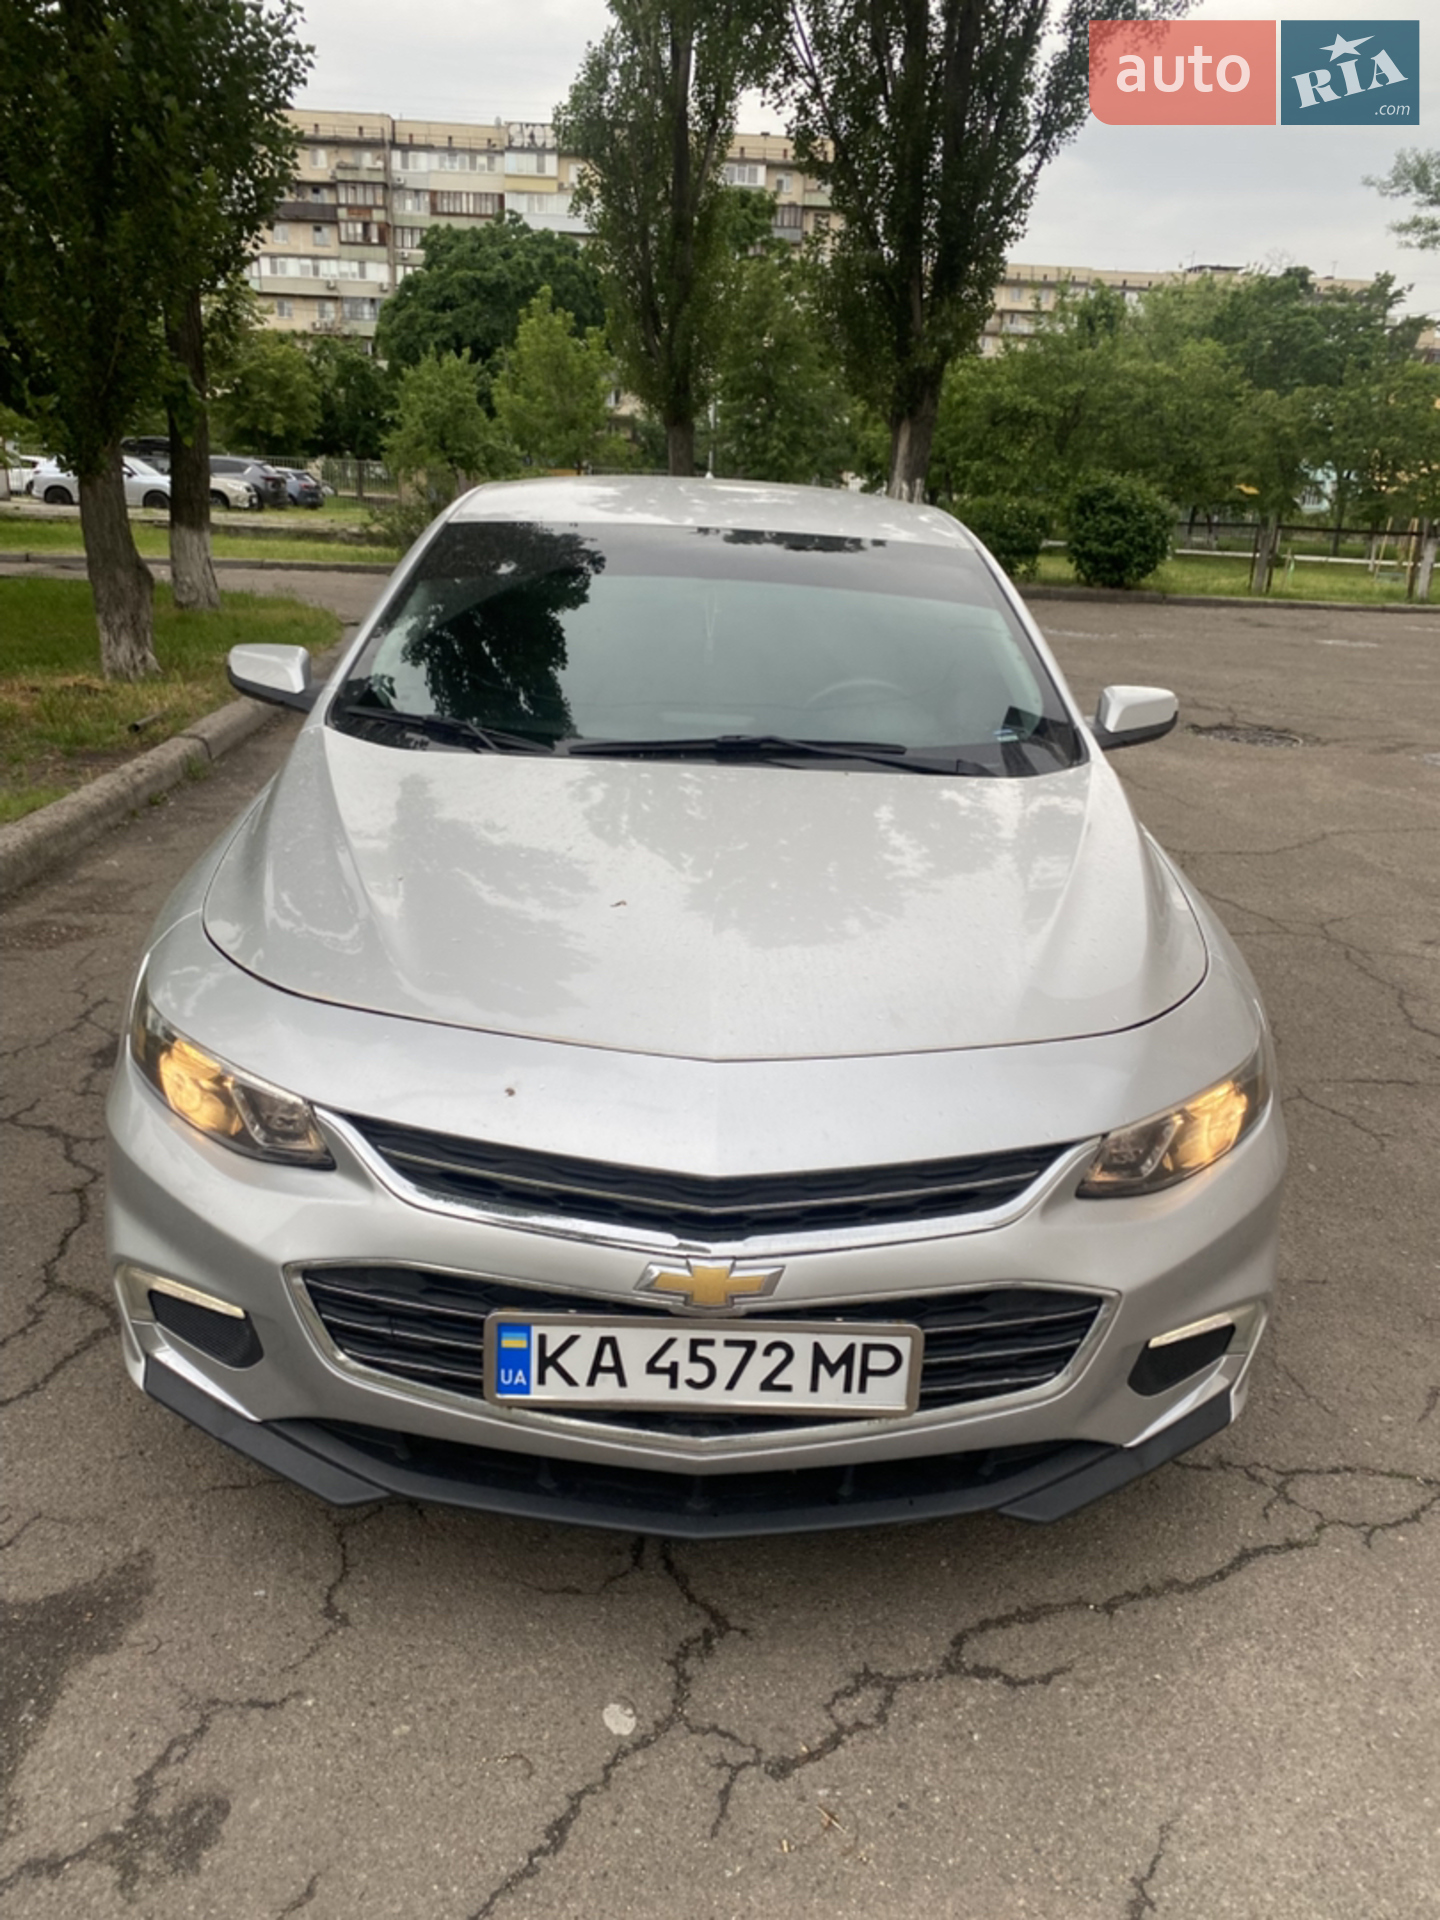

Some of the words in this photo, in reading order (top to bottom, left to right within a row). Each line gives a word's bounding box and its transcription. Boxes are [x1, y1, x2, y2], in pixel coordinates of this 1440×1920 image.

[500, 1368, 527, 1386] UA
[536, 1332, 628, 1389] KA
[645, 1337, 796, 1393] 4572
[809, 1340, 904, 1395] MP
